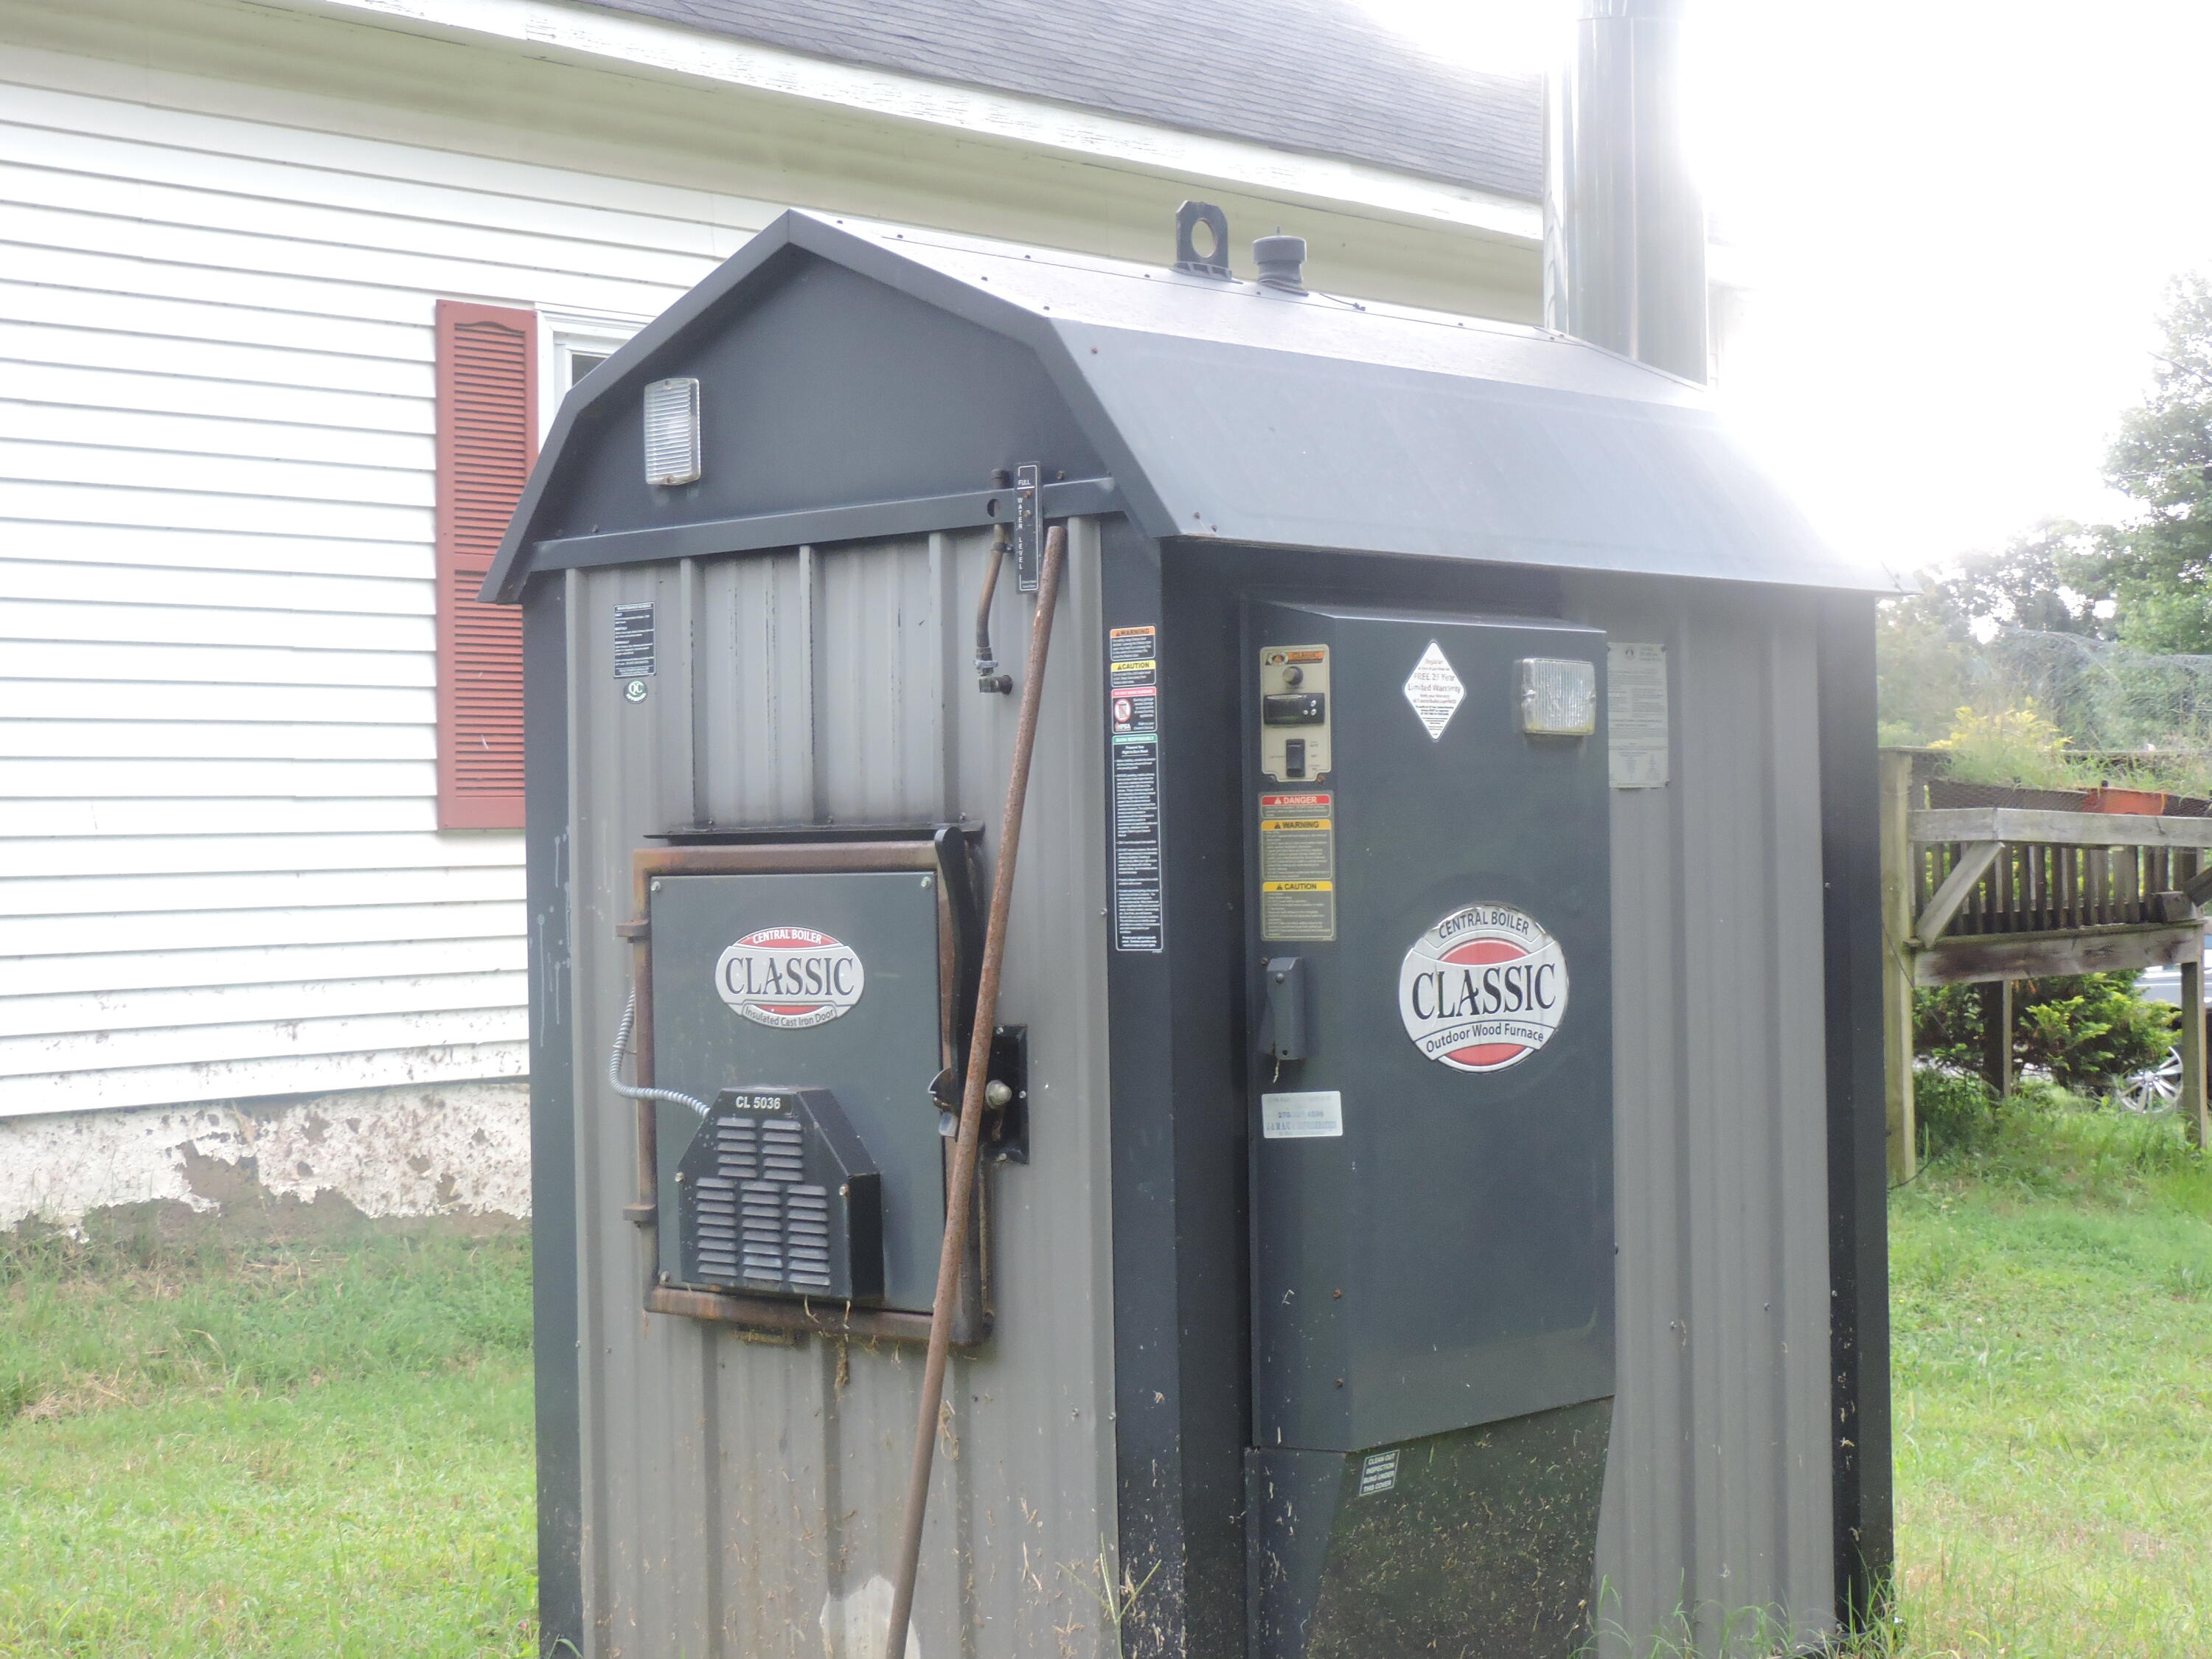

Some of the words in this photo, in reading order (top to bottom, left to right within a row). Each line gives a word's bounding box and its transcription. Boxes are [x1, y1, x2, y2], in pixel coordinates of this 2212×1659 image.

[1121, 661, 1150, 670] CAUTION
[1413, 672, 1430, 681] FREE
[1441, 673, 1455, 681] Year
[628, 681, 645, 695] QC
[1432, 684, 1461, 694] Warranty
[1283, 796, 1318, 804] DANGER
[1282, 821, 1320, 829] WARNING
[1284, 883, 1318, 891] CAUTION
[1439, 912, 1489, 939] CENTRAL
[1491, 911, 1529, 936] BOILER
[752, 929, 790, 945] CENTRAL
[791, 928, 823, 945] BOILER
[726, 957, 855, 996] CLASSIC
[1411, 963, 1557, 1020] CLASSIC
[745, 1006, 779, 1026] Insulated
[780, 1017, 798, 1027] Cast
[799, 1016, 814, 1026] Iron
[815, 1009, 835, 1023] Door
[1426, 1029, 1471, 1053] Outdoor
[1472, 1022, 1502, 1037] Wood
[1504, 1023, 1544, 1043] Furnace
[736, 1096, 751, 1108] CL
[753, 1096, 781, 1110] 5036
